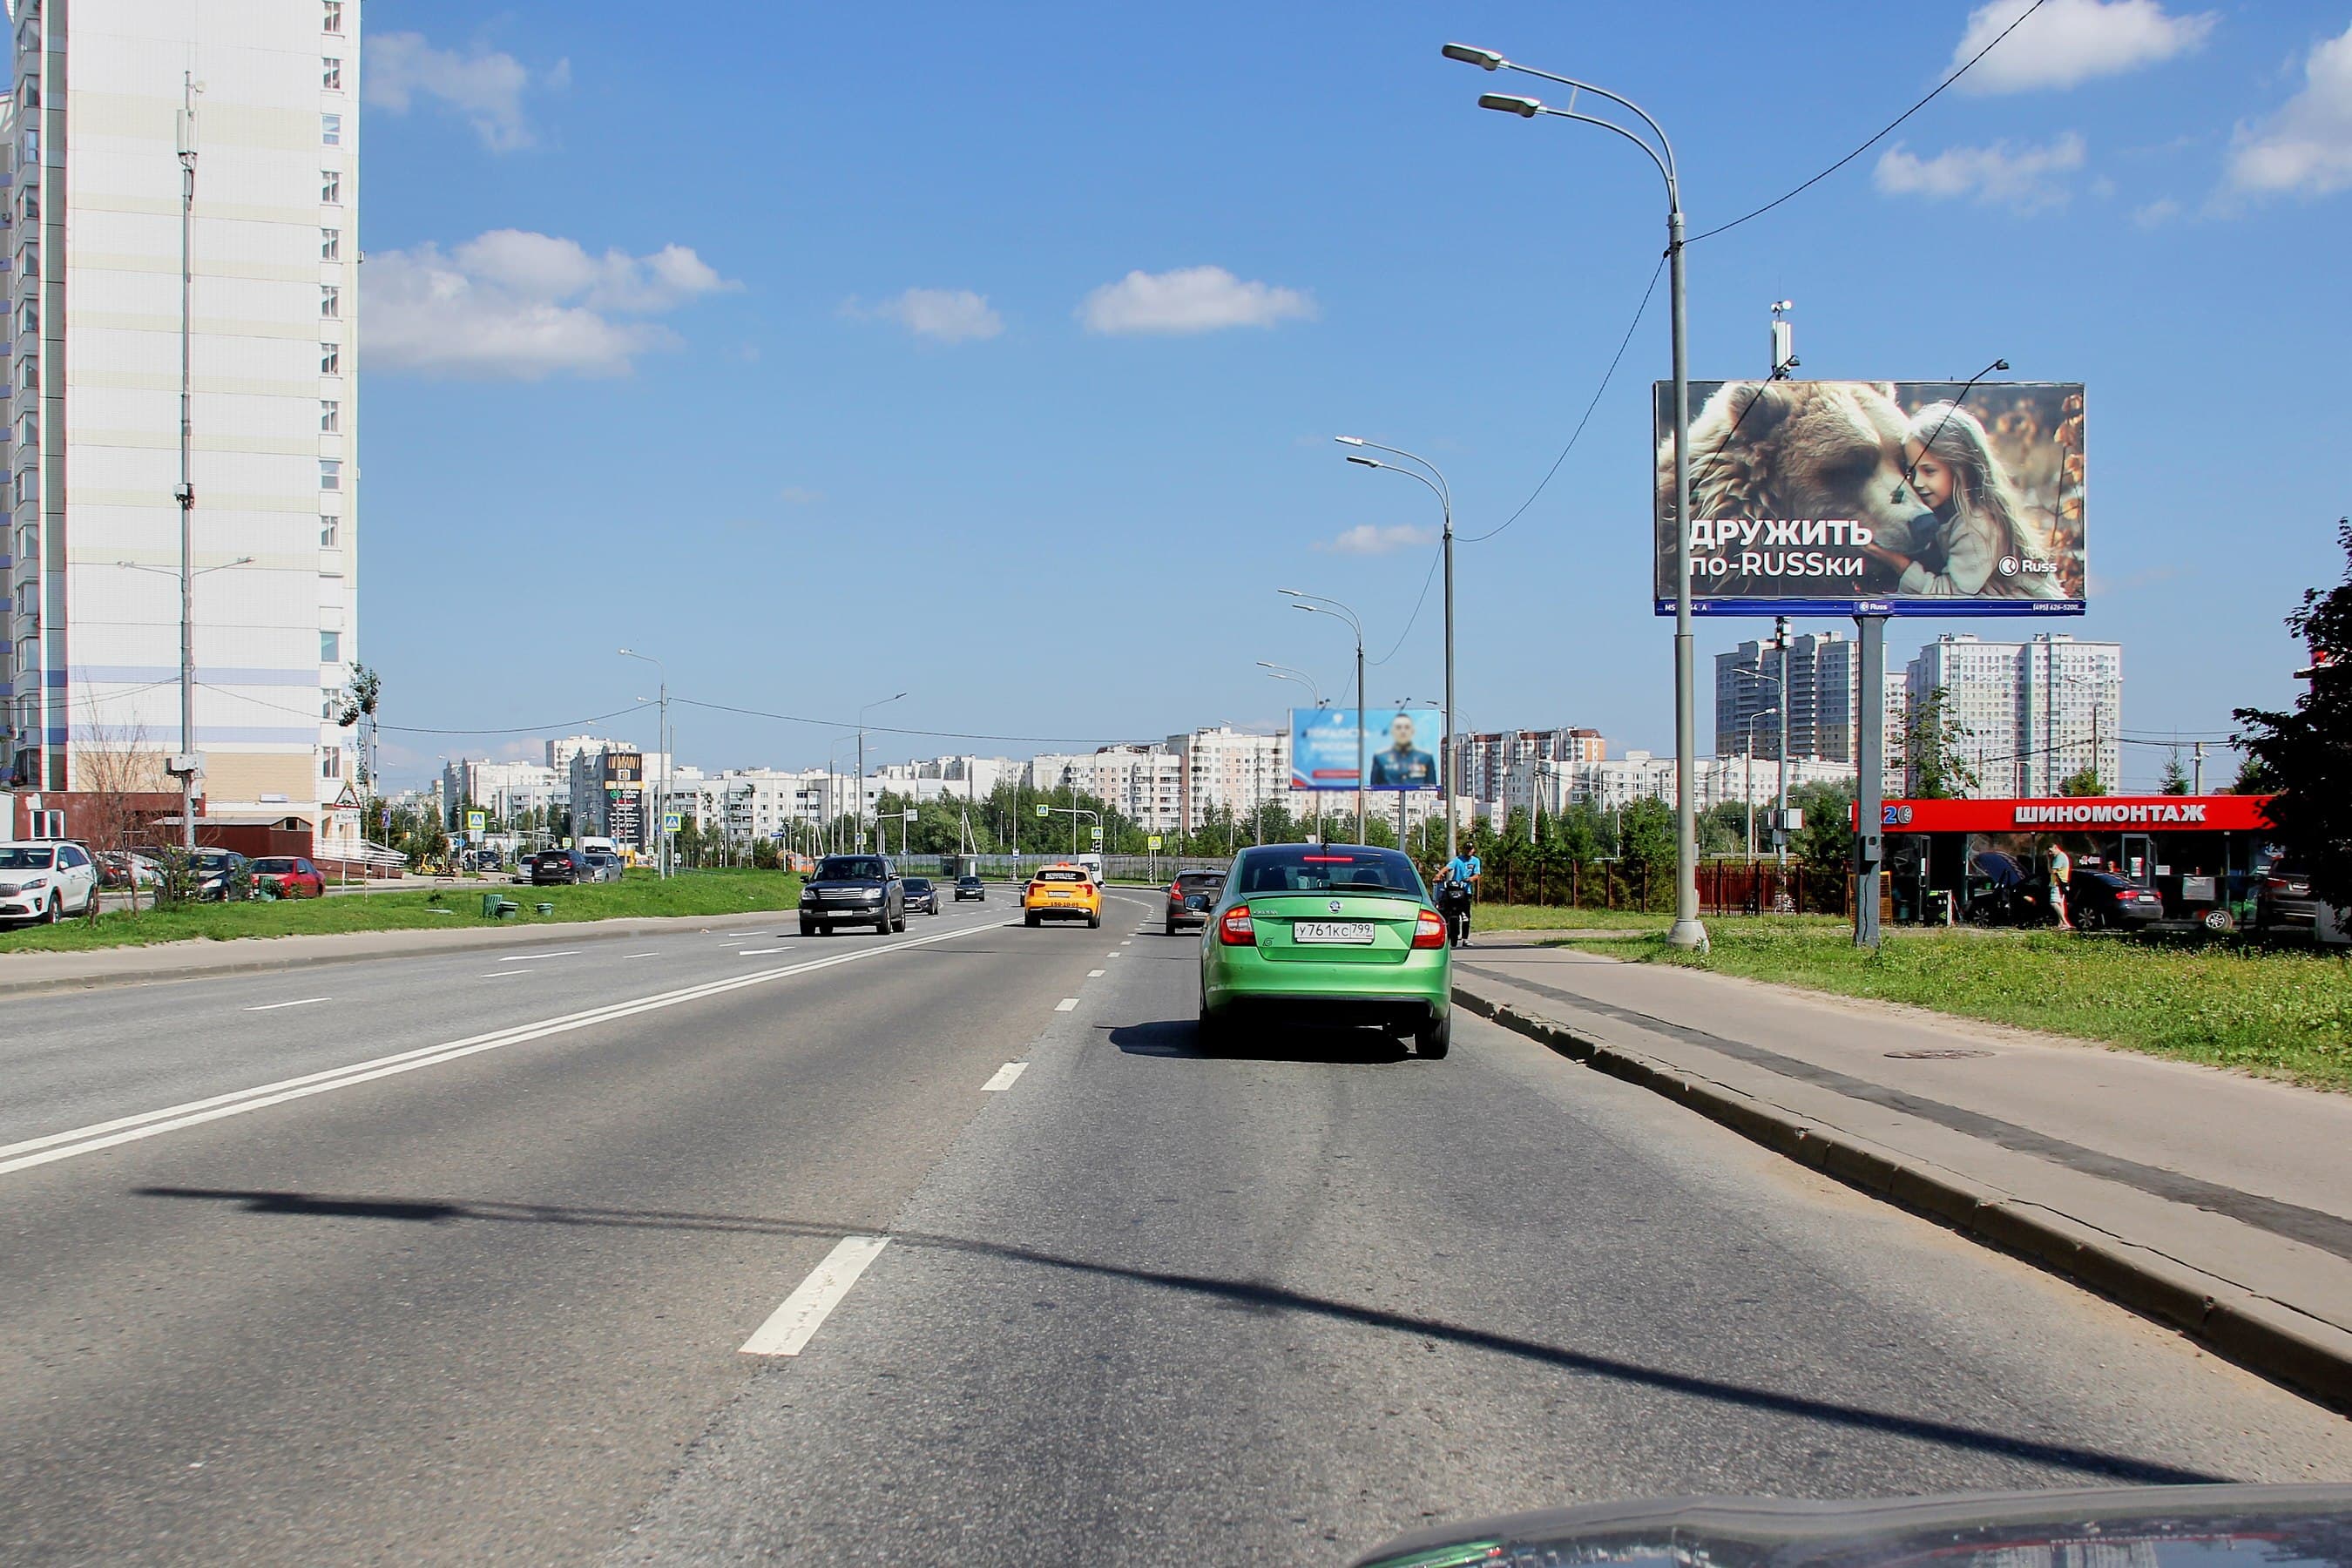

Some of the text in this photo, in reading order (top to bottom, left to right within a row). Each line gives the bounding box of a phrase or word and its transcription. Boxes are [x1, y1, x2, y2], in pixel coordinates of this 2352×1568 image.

[1689, 519, 1873, 550] ДРУЖИТЬ
[1689, 551, 1863, 576] по-RUSSки
[2022, 559, 2058, 573] Russ
[2015, 804, 2207, 822] ШИНОМОНТАЖ
[1351, 923, 1370, 934] 799
